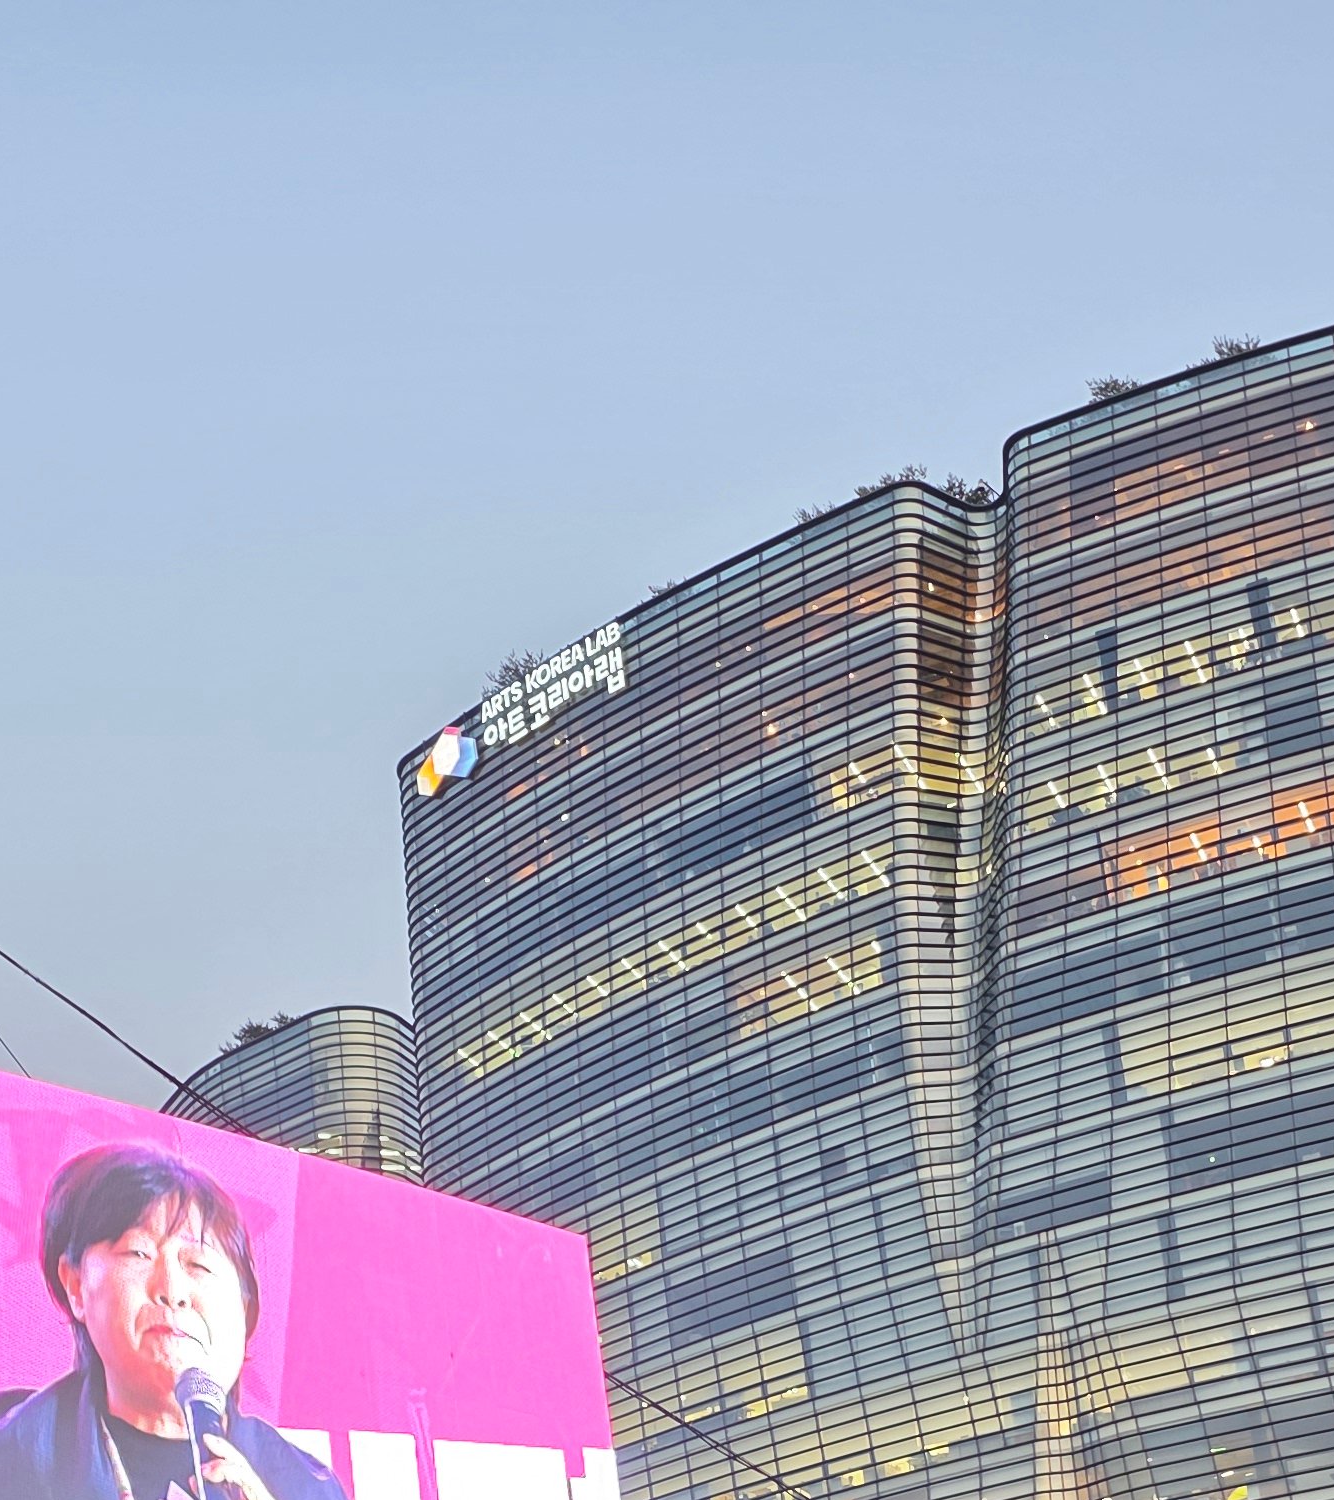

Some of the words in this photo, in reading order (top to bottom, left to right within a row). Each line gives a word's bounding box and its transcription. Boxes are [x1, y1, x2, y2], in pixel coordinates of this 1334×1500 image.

[481, 682, 523, 724] ARTS
[524, 643, 584, 694] KOREA
[584, 622, 622, 658] LAB
